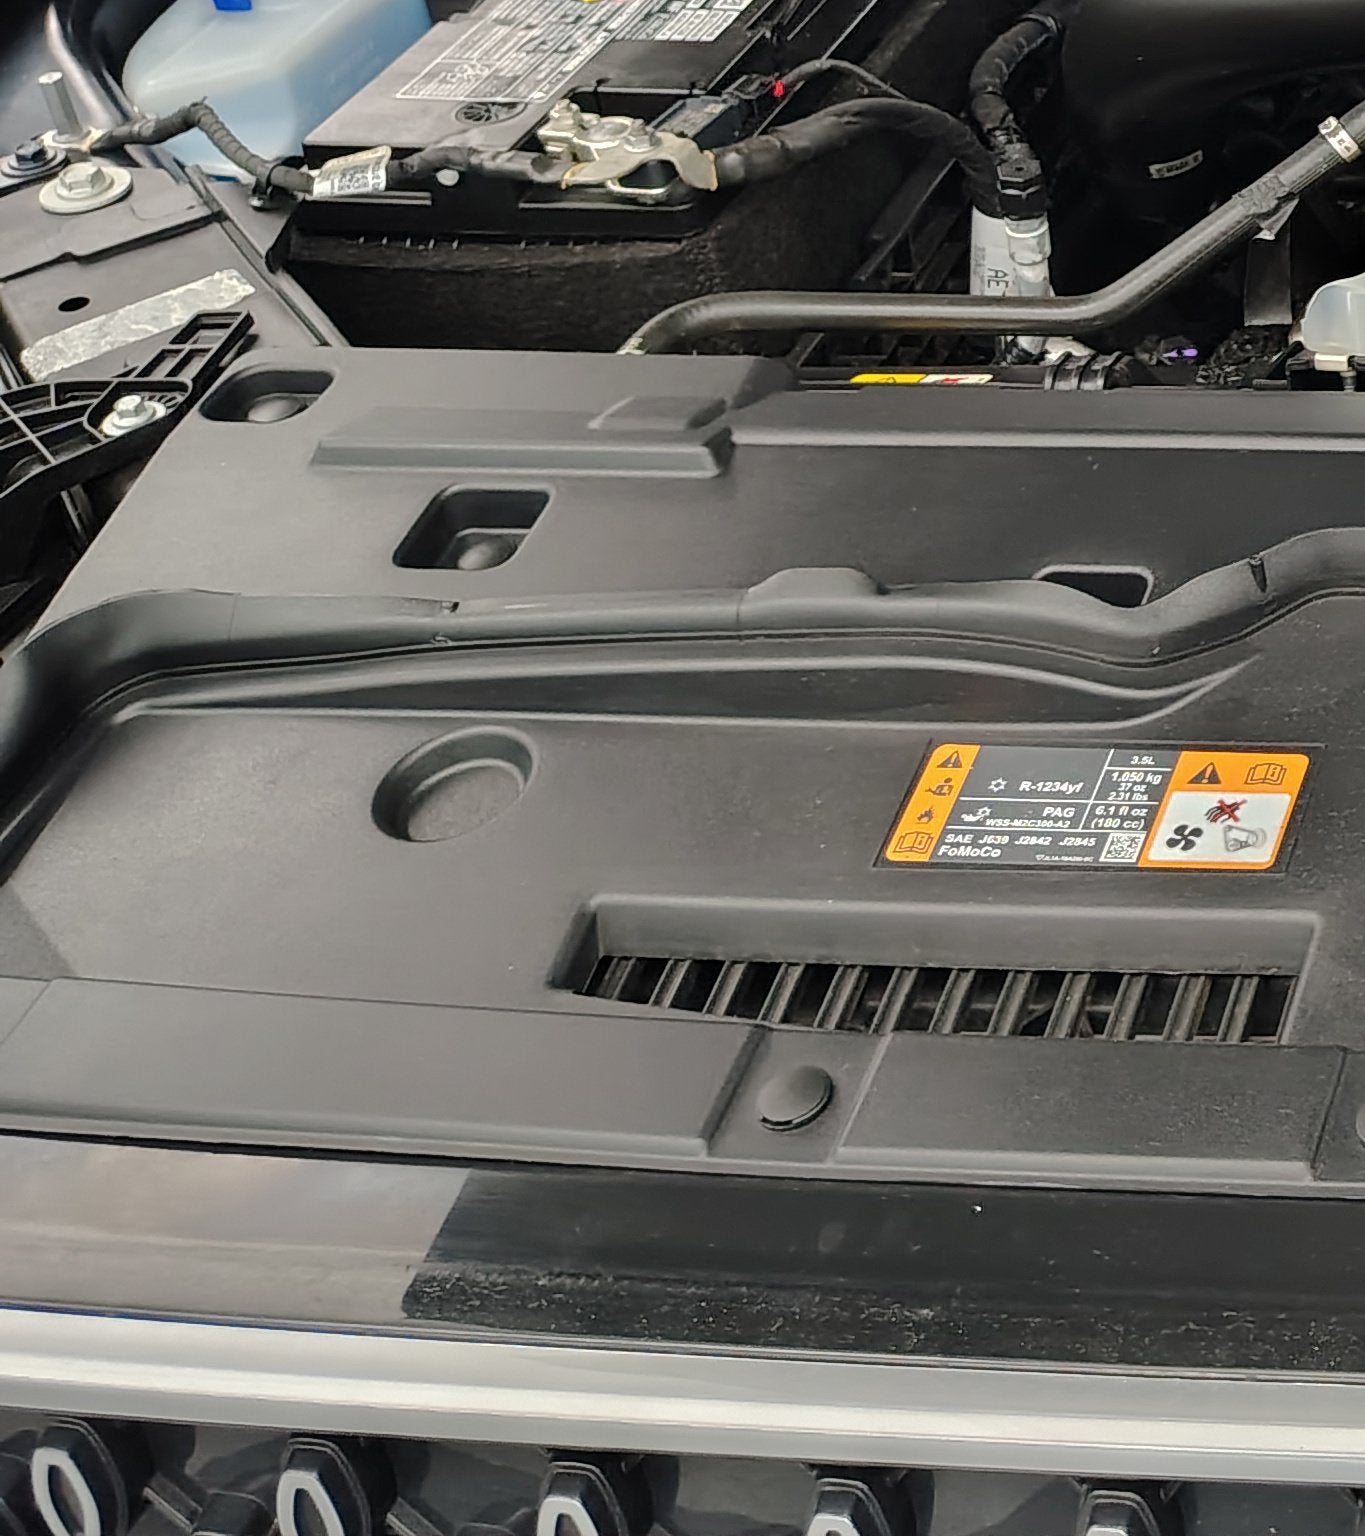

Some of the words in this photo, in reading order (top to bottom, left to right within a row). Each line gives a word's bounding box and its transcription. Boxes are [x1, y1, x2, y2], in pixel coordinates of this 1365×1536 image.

[1130, 756, 1155, 765] 3.5L
[1111, 771, 1145, 783] 1.050
[1145, 773, 1163, 785] kg
[1019, 781, 1085, 795] R-1234yf
[1118, 783, 1131, 791] 37
[1132, 784, 1148, 792] oz
[1131, 792, 1149, 801] lbs
[1042, 807, 1075, 818] PAG
[1095, 806, 1115, 816] 6.1
[1117, 806, 1129, 816] fl
[1130, 808, 1149, 817] oz
[1091, 818, 1120, 829] (180
[1122, 819, 1145, 830] cc)
[944, 833, 974, 844] SAE
[977, 835, 1010, 844] J639
[1014, 836, 1053, 846] J2842
[1058, 837, 1097, 847] J2845
[937, 845, 1002, 858] FoMoCo
